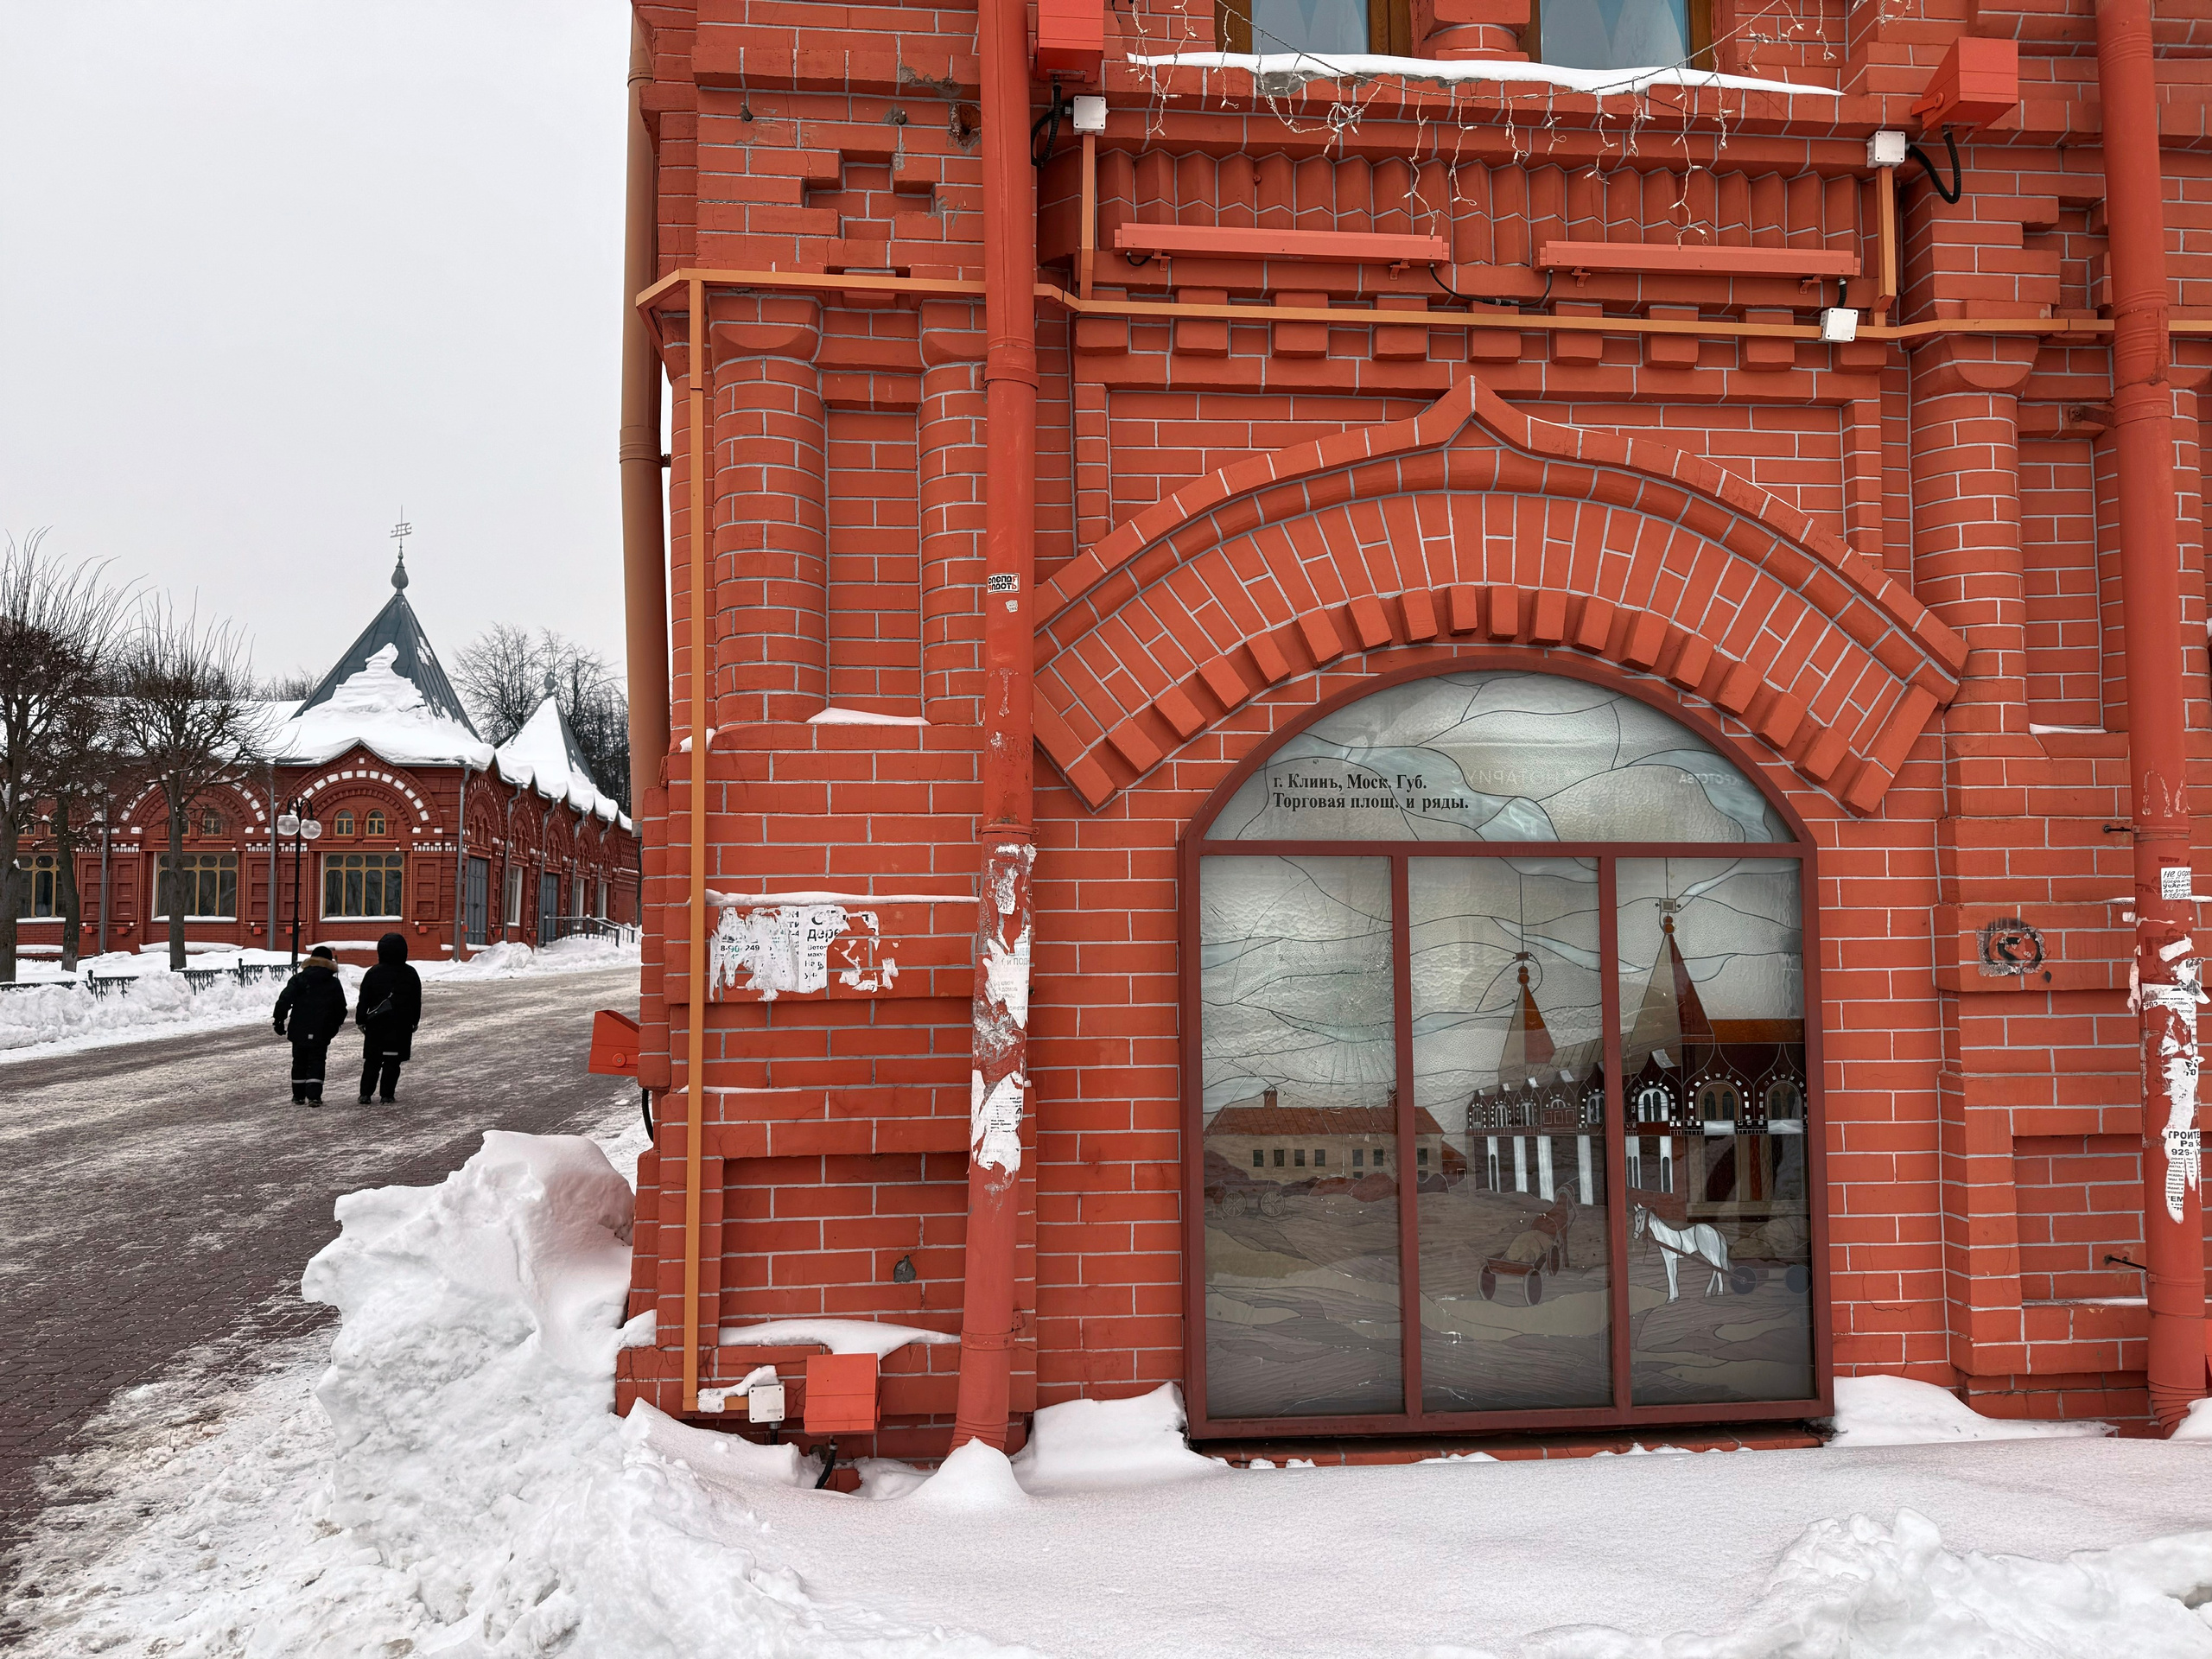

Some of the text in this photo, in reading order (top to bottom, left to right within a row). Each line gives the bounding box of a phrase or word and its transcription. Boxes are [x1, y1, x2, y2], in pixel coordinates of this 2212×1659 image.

[1273, 773, 1427, 792] г. Клинъ, Моск. Губ.
[1273, 792, 1469, 812] Торговая площ. и ряды.
